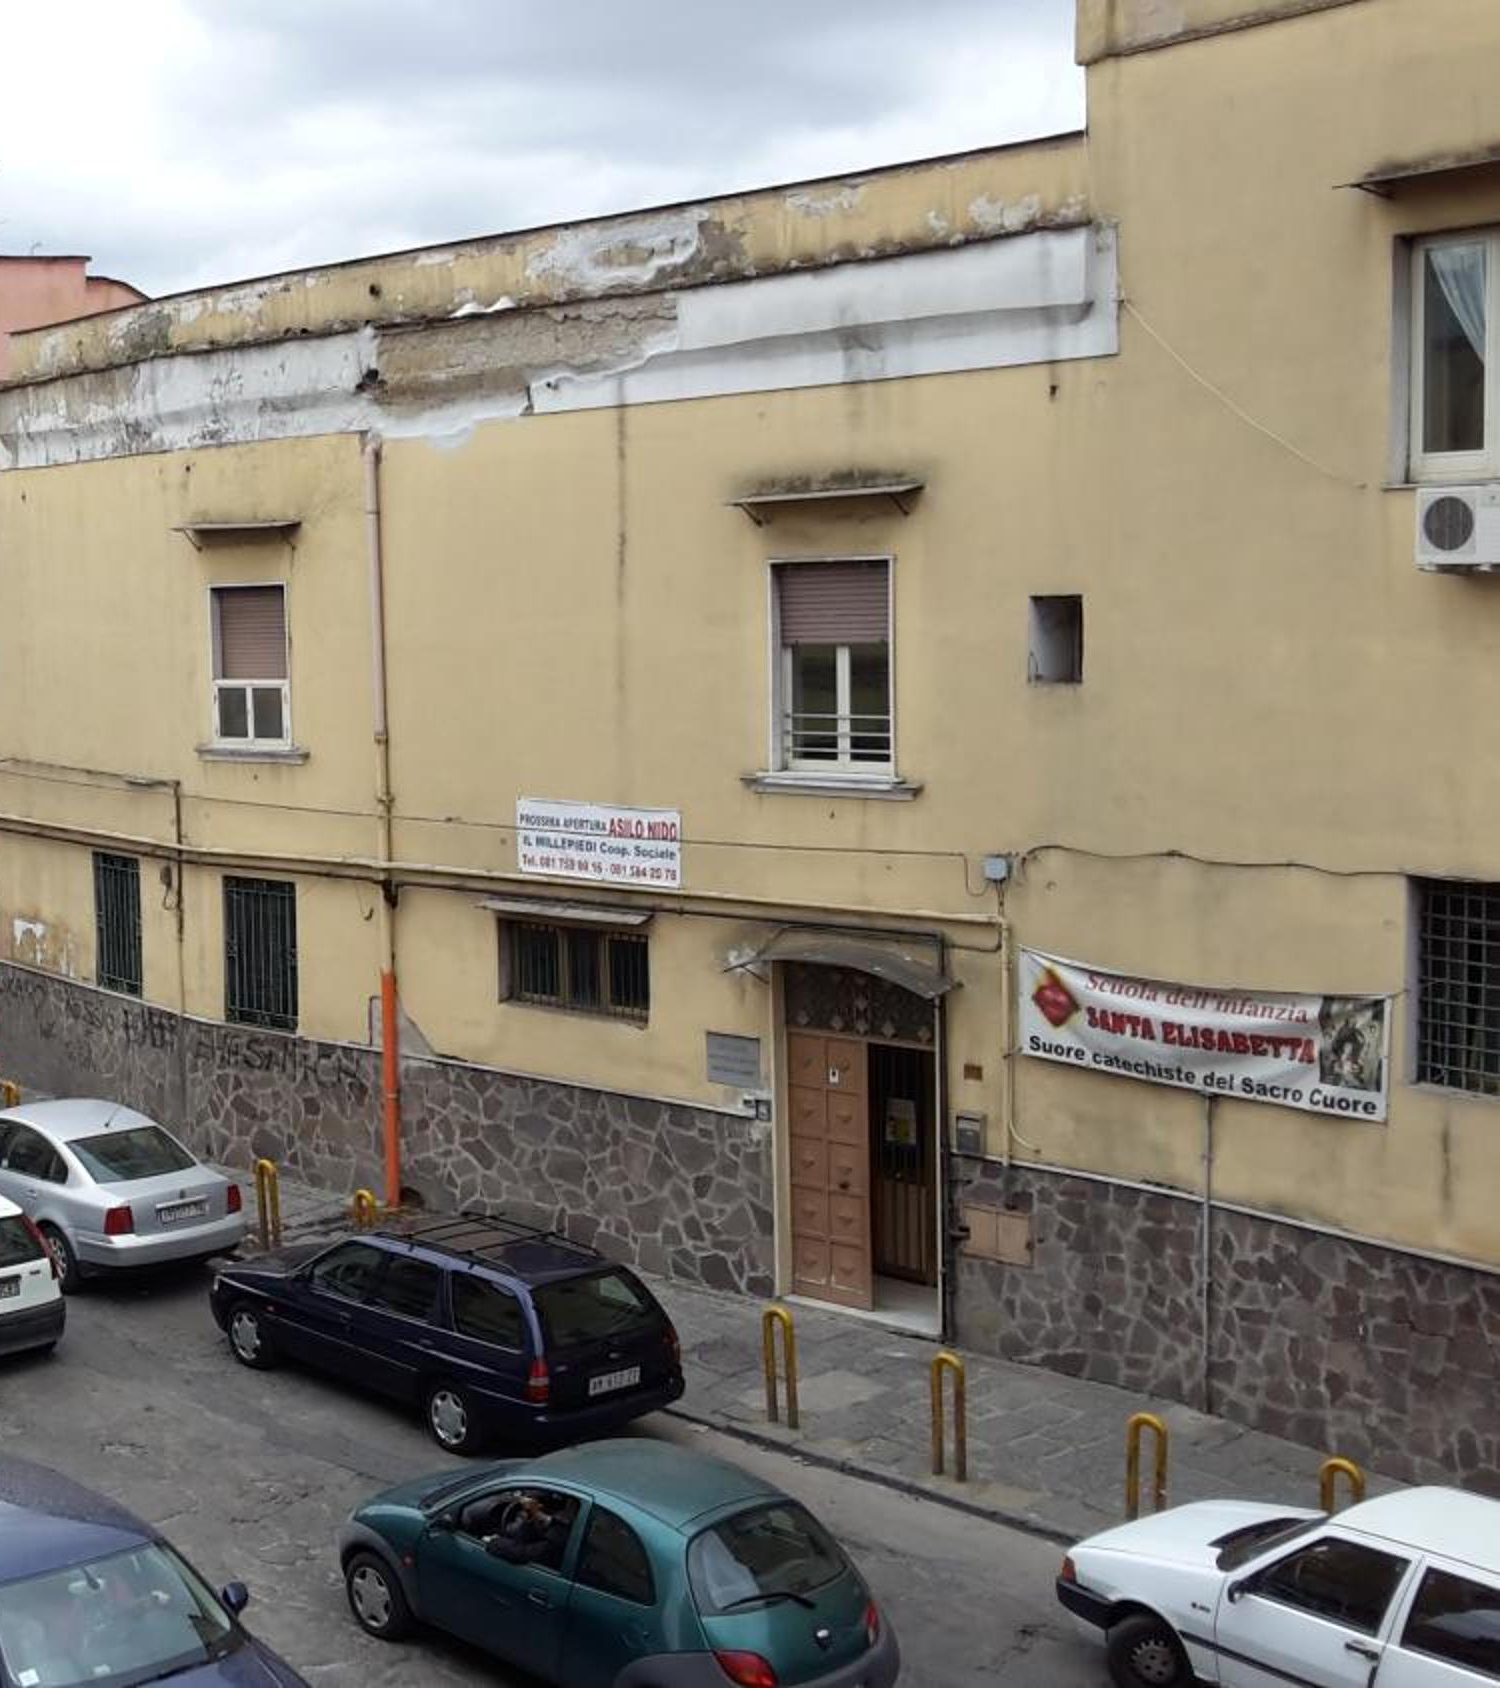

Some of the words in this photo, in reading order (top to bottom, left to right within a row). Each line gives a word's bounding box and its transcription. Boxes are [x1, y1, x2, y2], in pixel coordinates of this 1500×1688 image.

[609, 817, 643, 838] ASILO
[646, 820, 677, 842] NIDO
[599, 841, 631, 859] Coop.
[634, 845, 677, 861] Sociale
[1085, 974, 1157, 1004] Scuola
[1085, 1005, 1158, 1041] SANTA
[1160, 1020, 1317, 1065] ELISABETTA
[1028, 1035, 1086, 1061] Suore
[1091, 1048, 1197, 1085] catechiste
[1202, 1071, 1236, 1092] del
[1241, 1076, 1305, 1104] Sacro
[1308, 1087, 1379, 1117] Cuore
